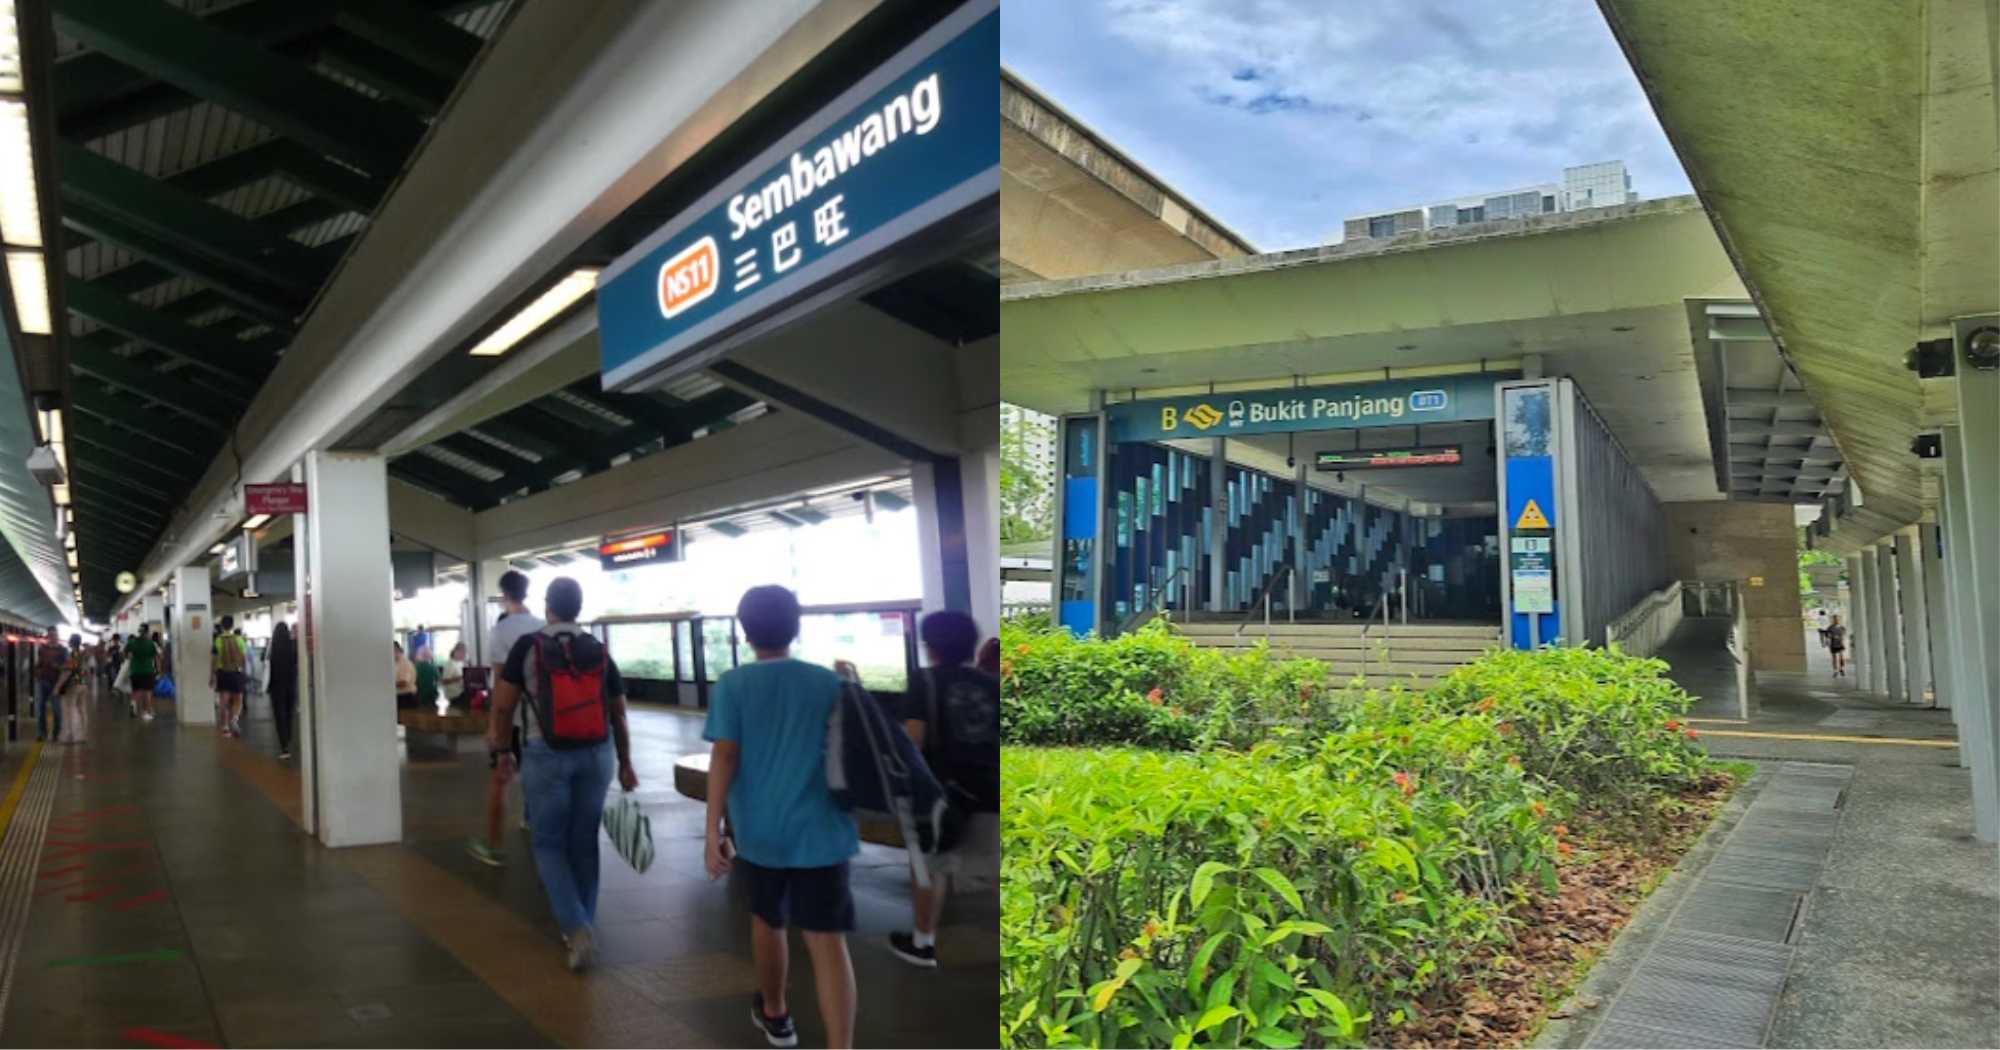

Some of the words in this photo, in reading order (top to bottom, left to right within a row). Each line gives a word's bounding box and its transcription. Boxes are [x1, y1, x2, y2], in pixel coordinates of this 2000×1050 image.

[728, 73, 941, 241] Sembawang
[734, 194, 849, 292] 三巴旺
[666, 258, 710, 299] NS11
[1162, 406, 1178, 431] B
[1250, 399, 1305, 423] Bukit
[1312, 395, 1404, 421] Panjang
[1418, 395, 1440, 406] DT1
